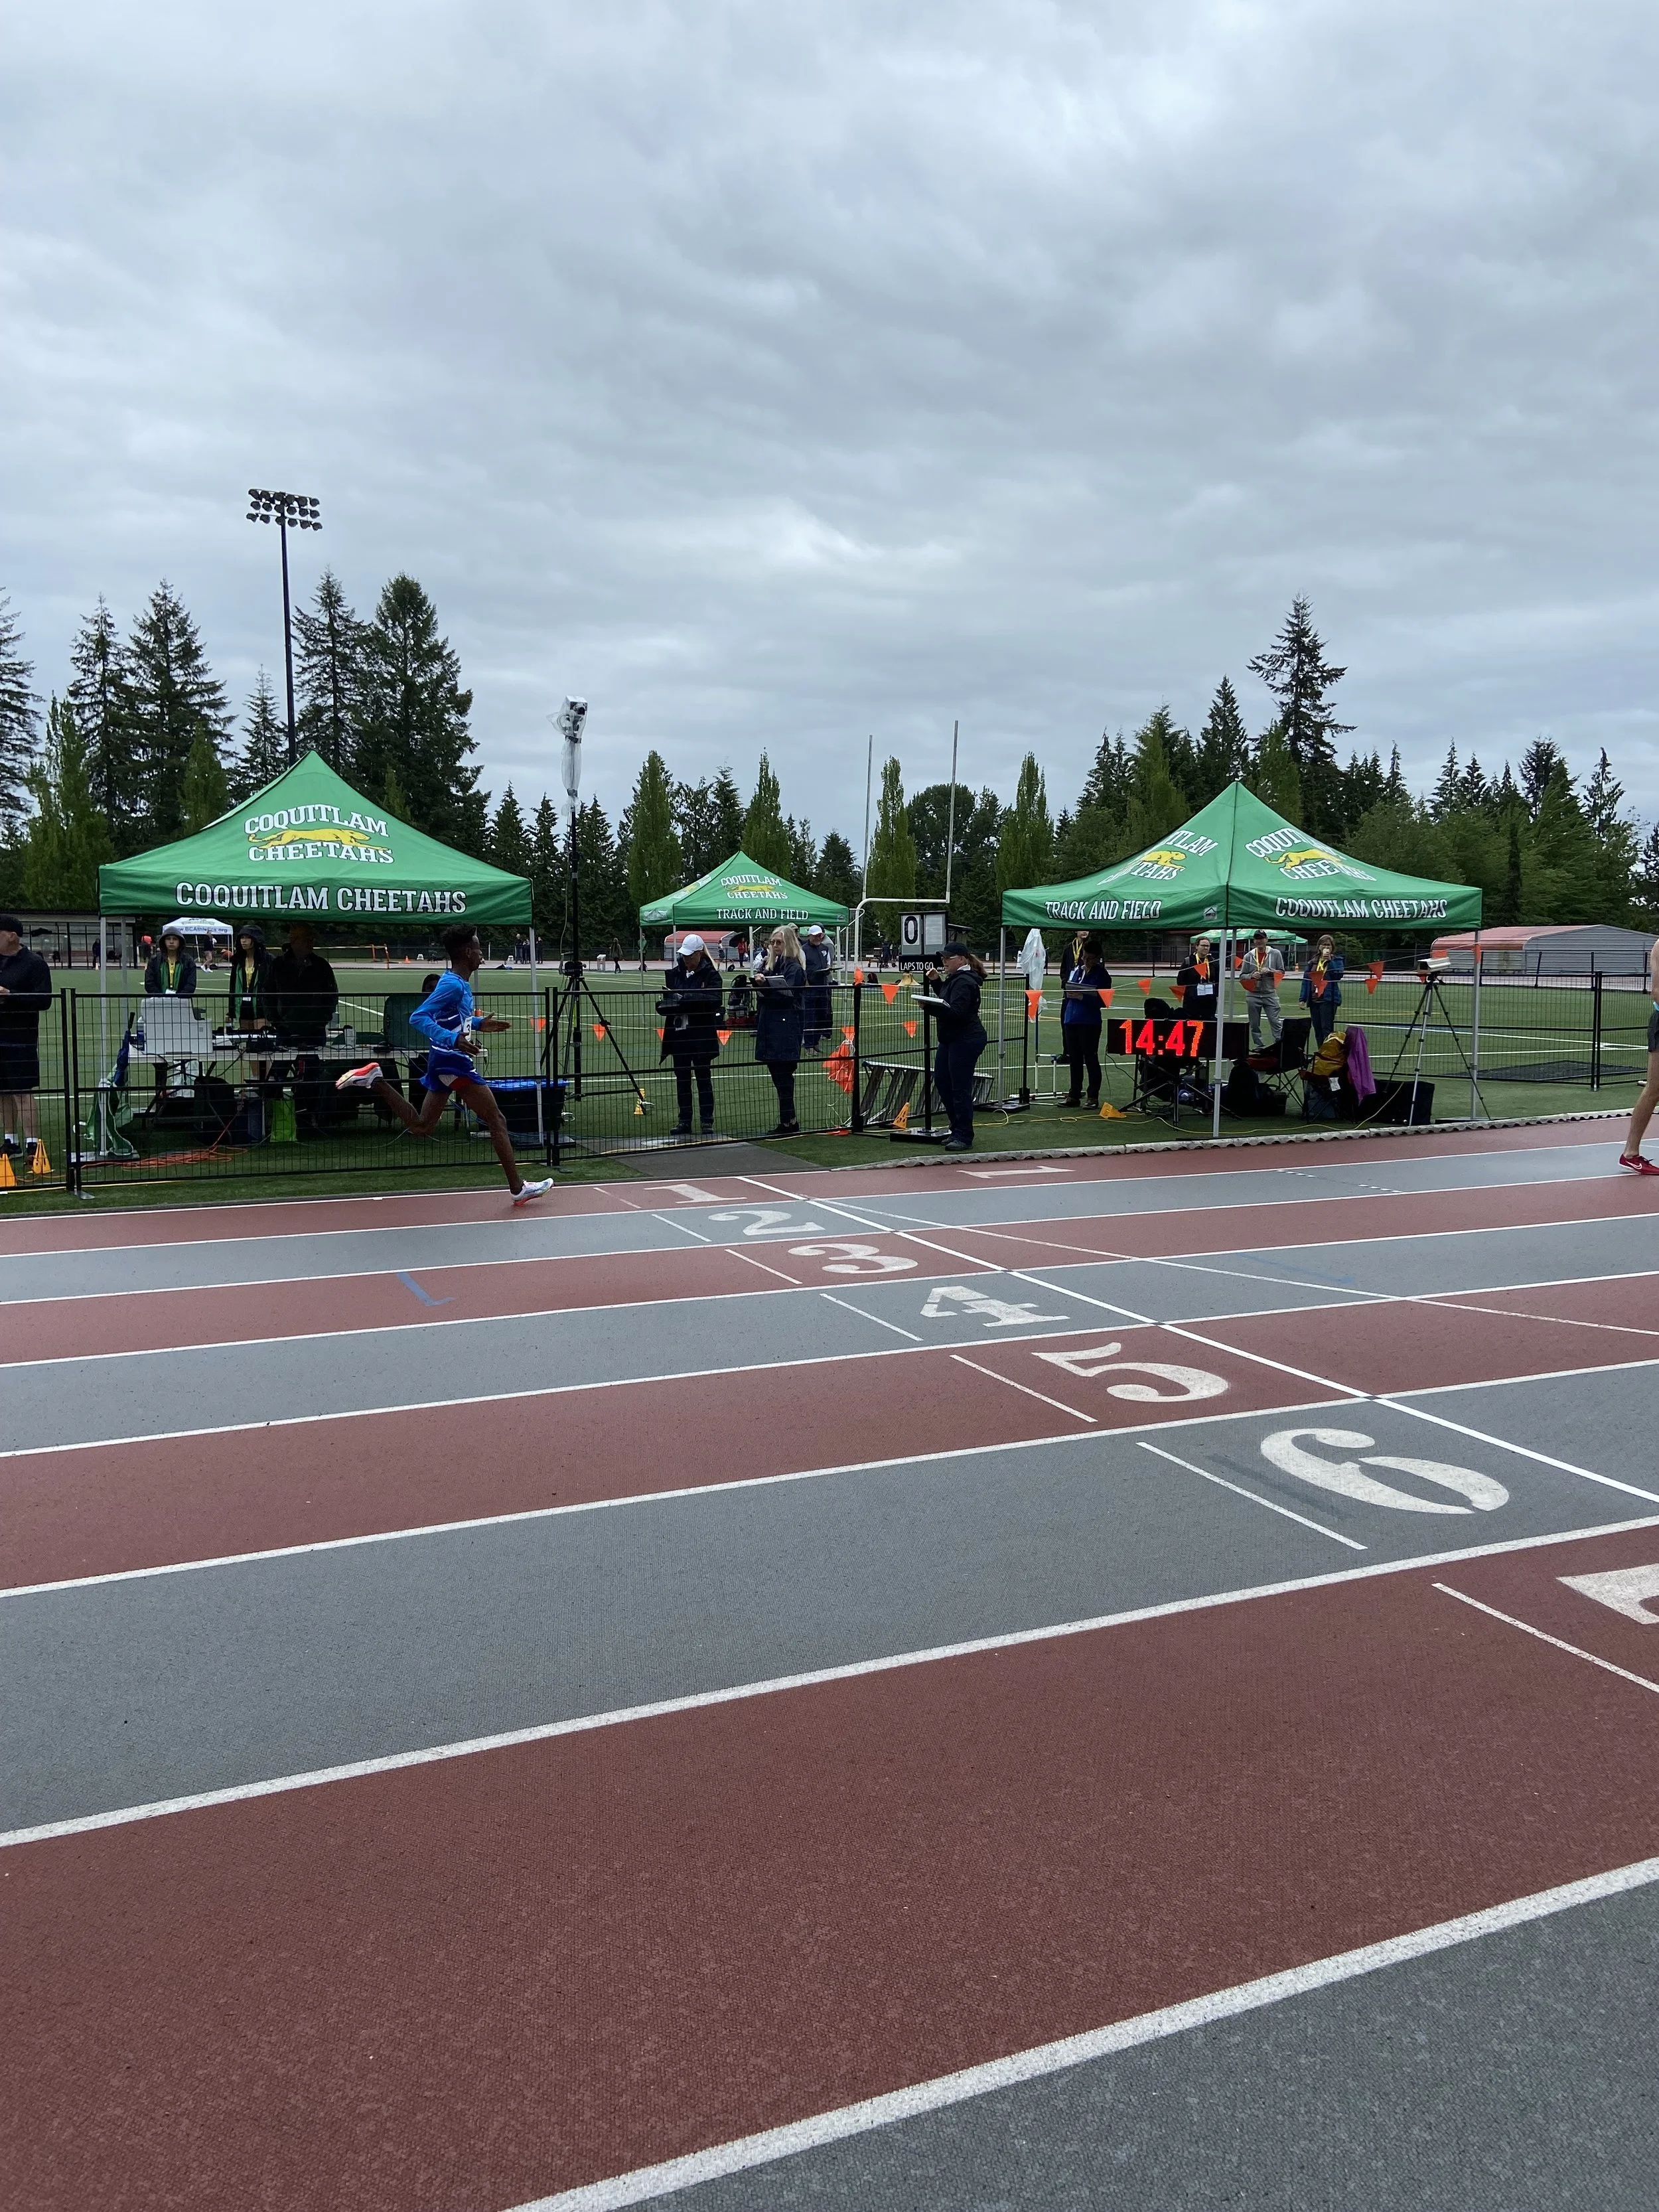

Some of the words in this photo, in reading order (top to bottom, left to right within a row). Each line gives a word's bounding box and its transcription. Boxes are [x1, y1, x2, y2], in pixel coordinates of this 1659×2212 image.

[244, 804, 390, 838] COQUITLAM
[248, 841, 394, 863] CHEETAHS
[1245, 828, 1346, 860] COQUIT
[720, 874, 783, 887] COQUITLAM
[176, 881, 329, 911] COQUITLAM
[336, 887, 467, 915] CHEETAHS
[727, 891, 788, 899] CHEETAHS
[1275, 897, 1370, 919] COQUITLAM
[1370, 899, 1448, 919] CHEETAHS
[716, 908, 752, 920] TRACK
[755, 908, 778, 920] AND
[780, 909, 809, 921] FIELD
[1045, 900, 1089, 921] TRACK
[1088, 901, 1119, 921] AND
[1121, 900, 1162, 920] FIELD
[904, 916, 918, 945] 0
[901, 962, 915, 970] LAPS
[916, 962, 924, 970] TO
[924, 962, 934, 970] GO
[1119, 1019, 1204, 1057] 14:47
[956, 1165, 1074, 1179] 1
[644, 1183, 748, 1204] 1
[707, 1209, 826, 1236] 2
[787, 1242, 918, 1274] 3
[920, 1286, 1070, 1327] 4
[1031, 1342, 1230, 1403] 5
[1260, 1428, 1510, 1514] 6
